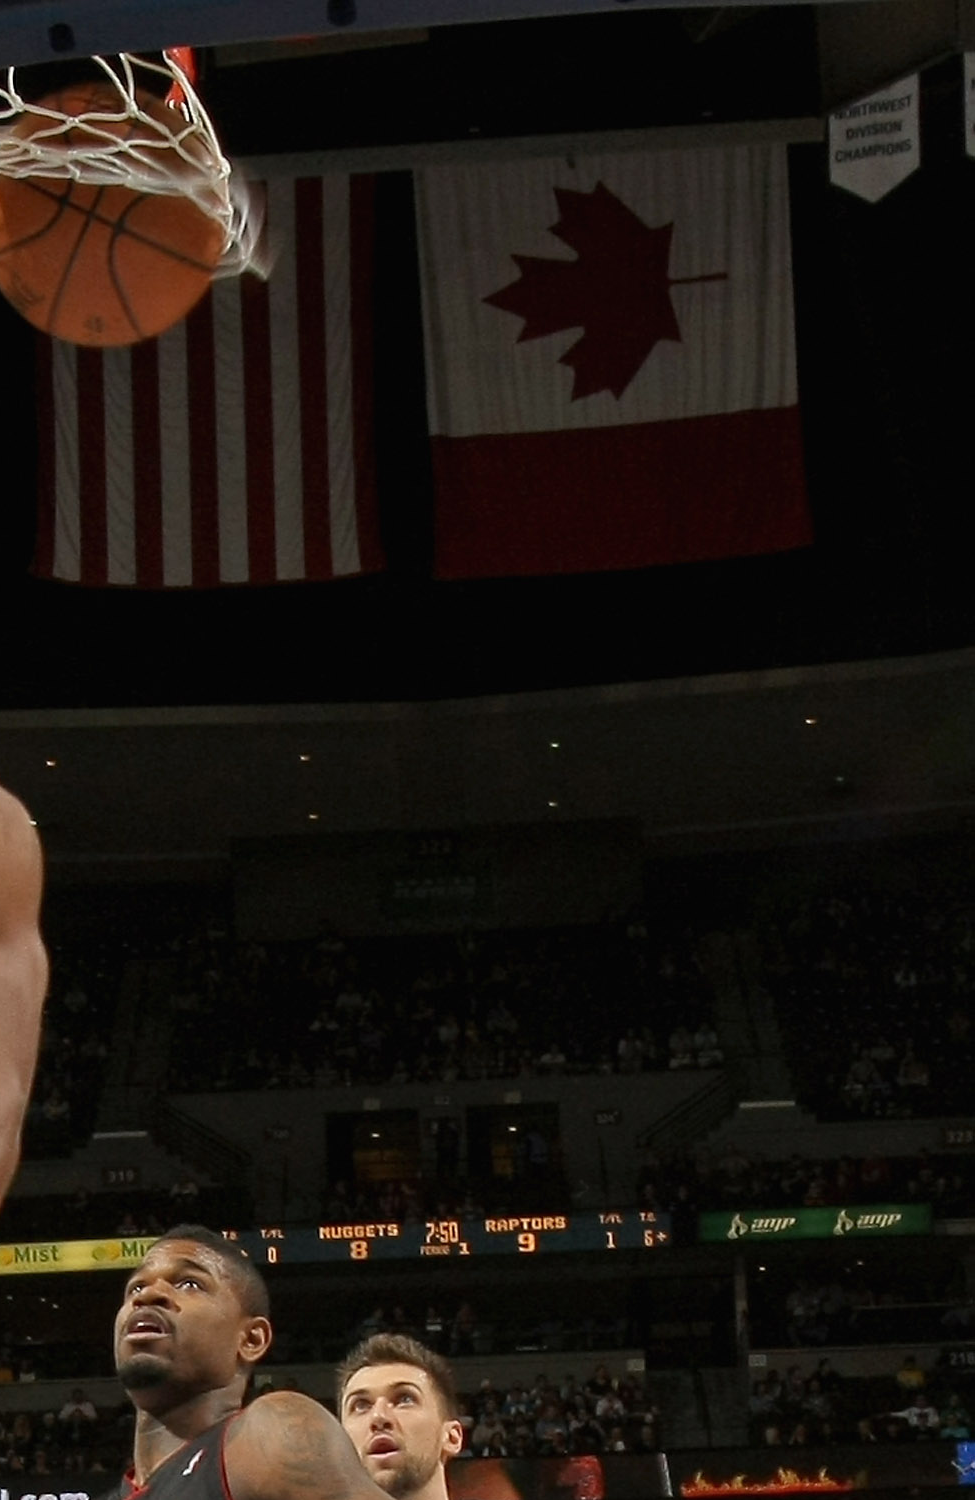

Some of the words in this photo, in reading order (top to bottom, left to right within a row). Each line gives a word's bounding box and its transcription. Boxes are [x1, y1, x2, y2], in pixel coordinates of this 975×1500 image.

[845, 120, 904, 140] DIVISION
[834, 138, 913, 164] CHAMPIONS
[318, 1223, 400, 1240] NUGGETS
[484, 1215, 568, 1232] RAPTORS
[458, 1241, 471, 1256] 1
[516, 1233, 537, 1253] 9
[605, 1231, 617, 1249] 1
[13, 1244, 61, 1265] Mist
[267, 1246, 277, 1264] 0
[349, 1240, 369, 1260] 8
